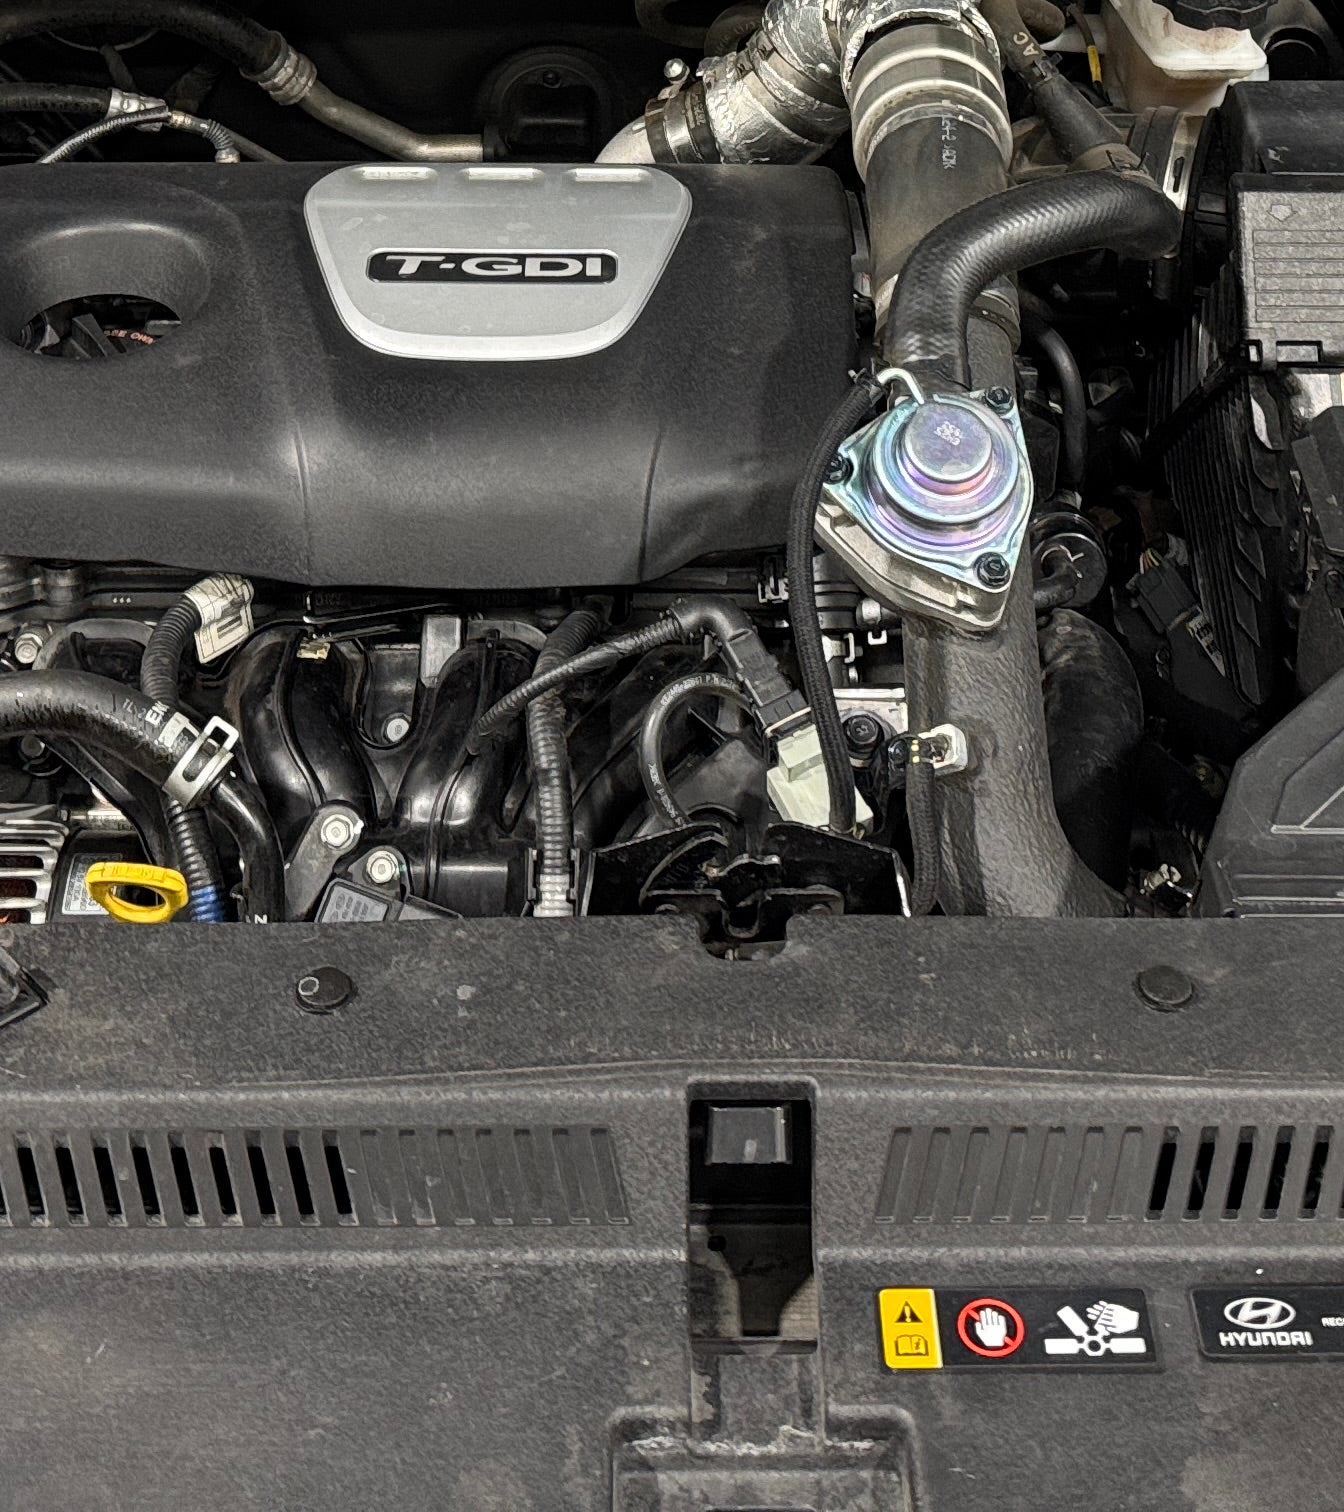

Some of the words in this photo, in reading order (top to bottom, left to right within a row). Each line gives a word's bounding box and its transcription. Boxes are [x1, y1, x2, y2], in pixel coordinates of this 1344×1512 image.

[1013, 31, 1040, 57] AC
[386, 254, 603, 278] T-GDI
[1218, 1331, 1314, 1347] HYUNDAI
